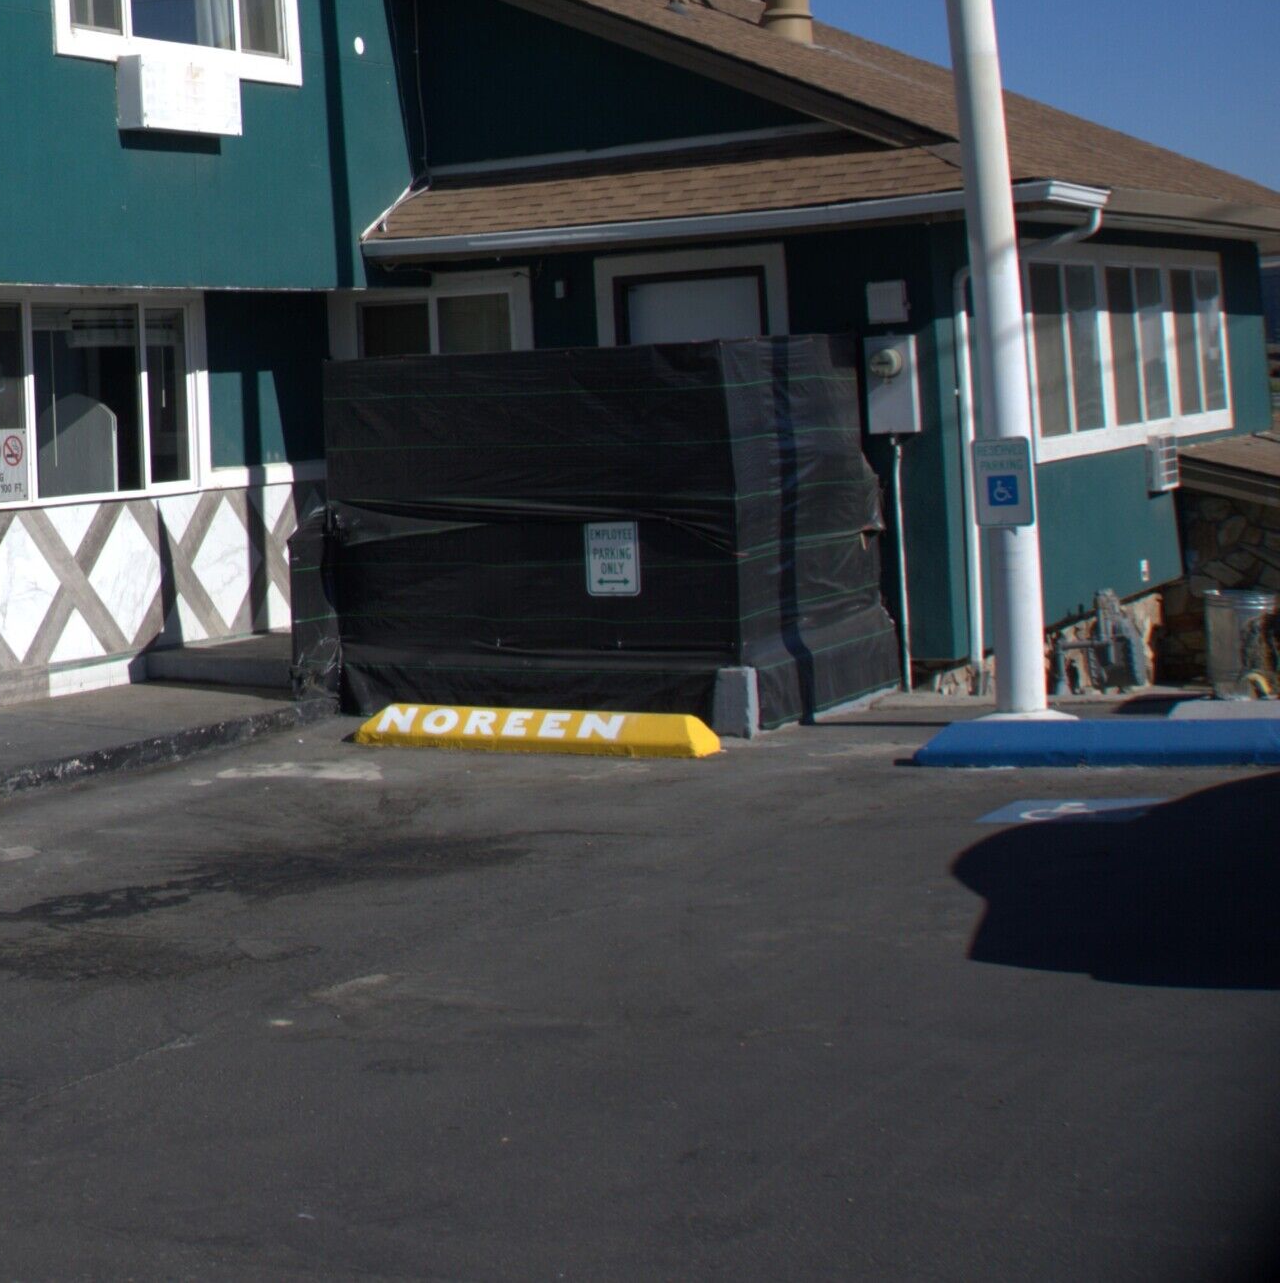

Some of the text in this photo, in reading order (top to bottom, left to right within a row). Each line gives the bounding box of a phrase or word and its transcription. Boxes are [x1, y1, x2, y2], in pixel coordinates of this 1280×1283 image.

[589, 527, 633, 541] EMPLOYEE
[592, 546, 632, 560] PARKING
[600, 561, 625, 575] ONLY
[375, 703, 627, 741] NOREEN
